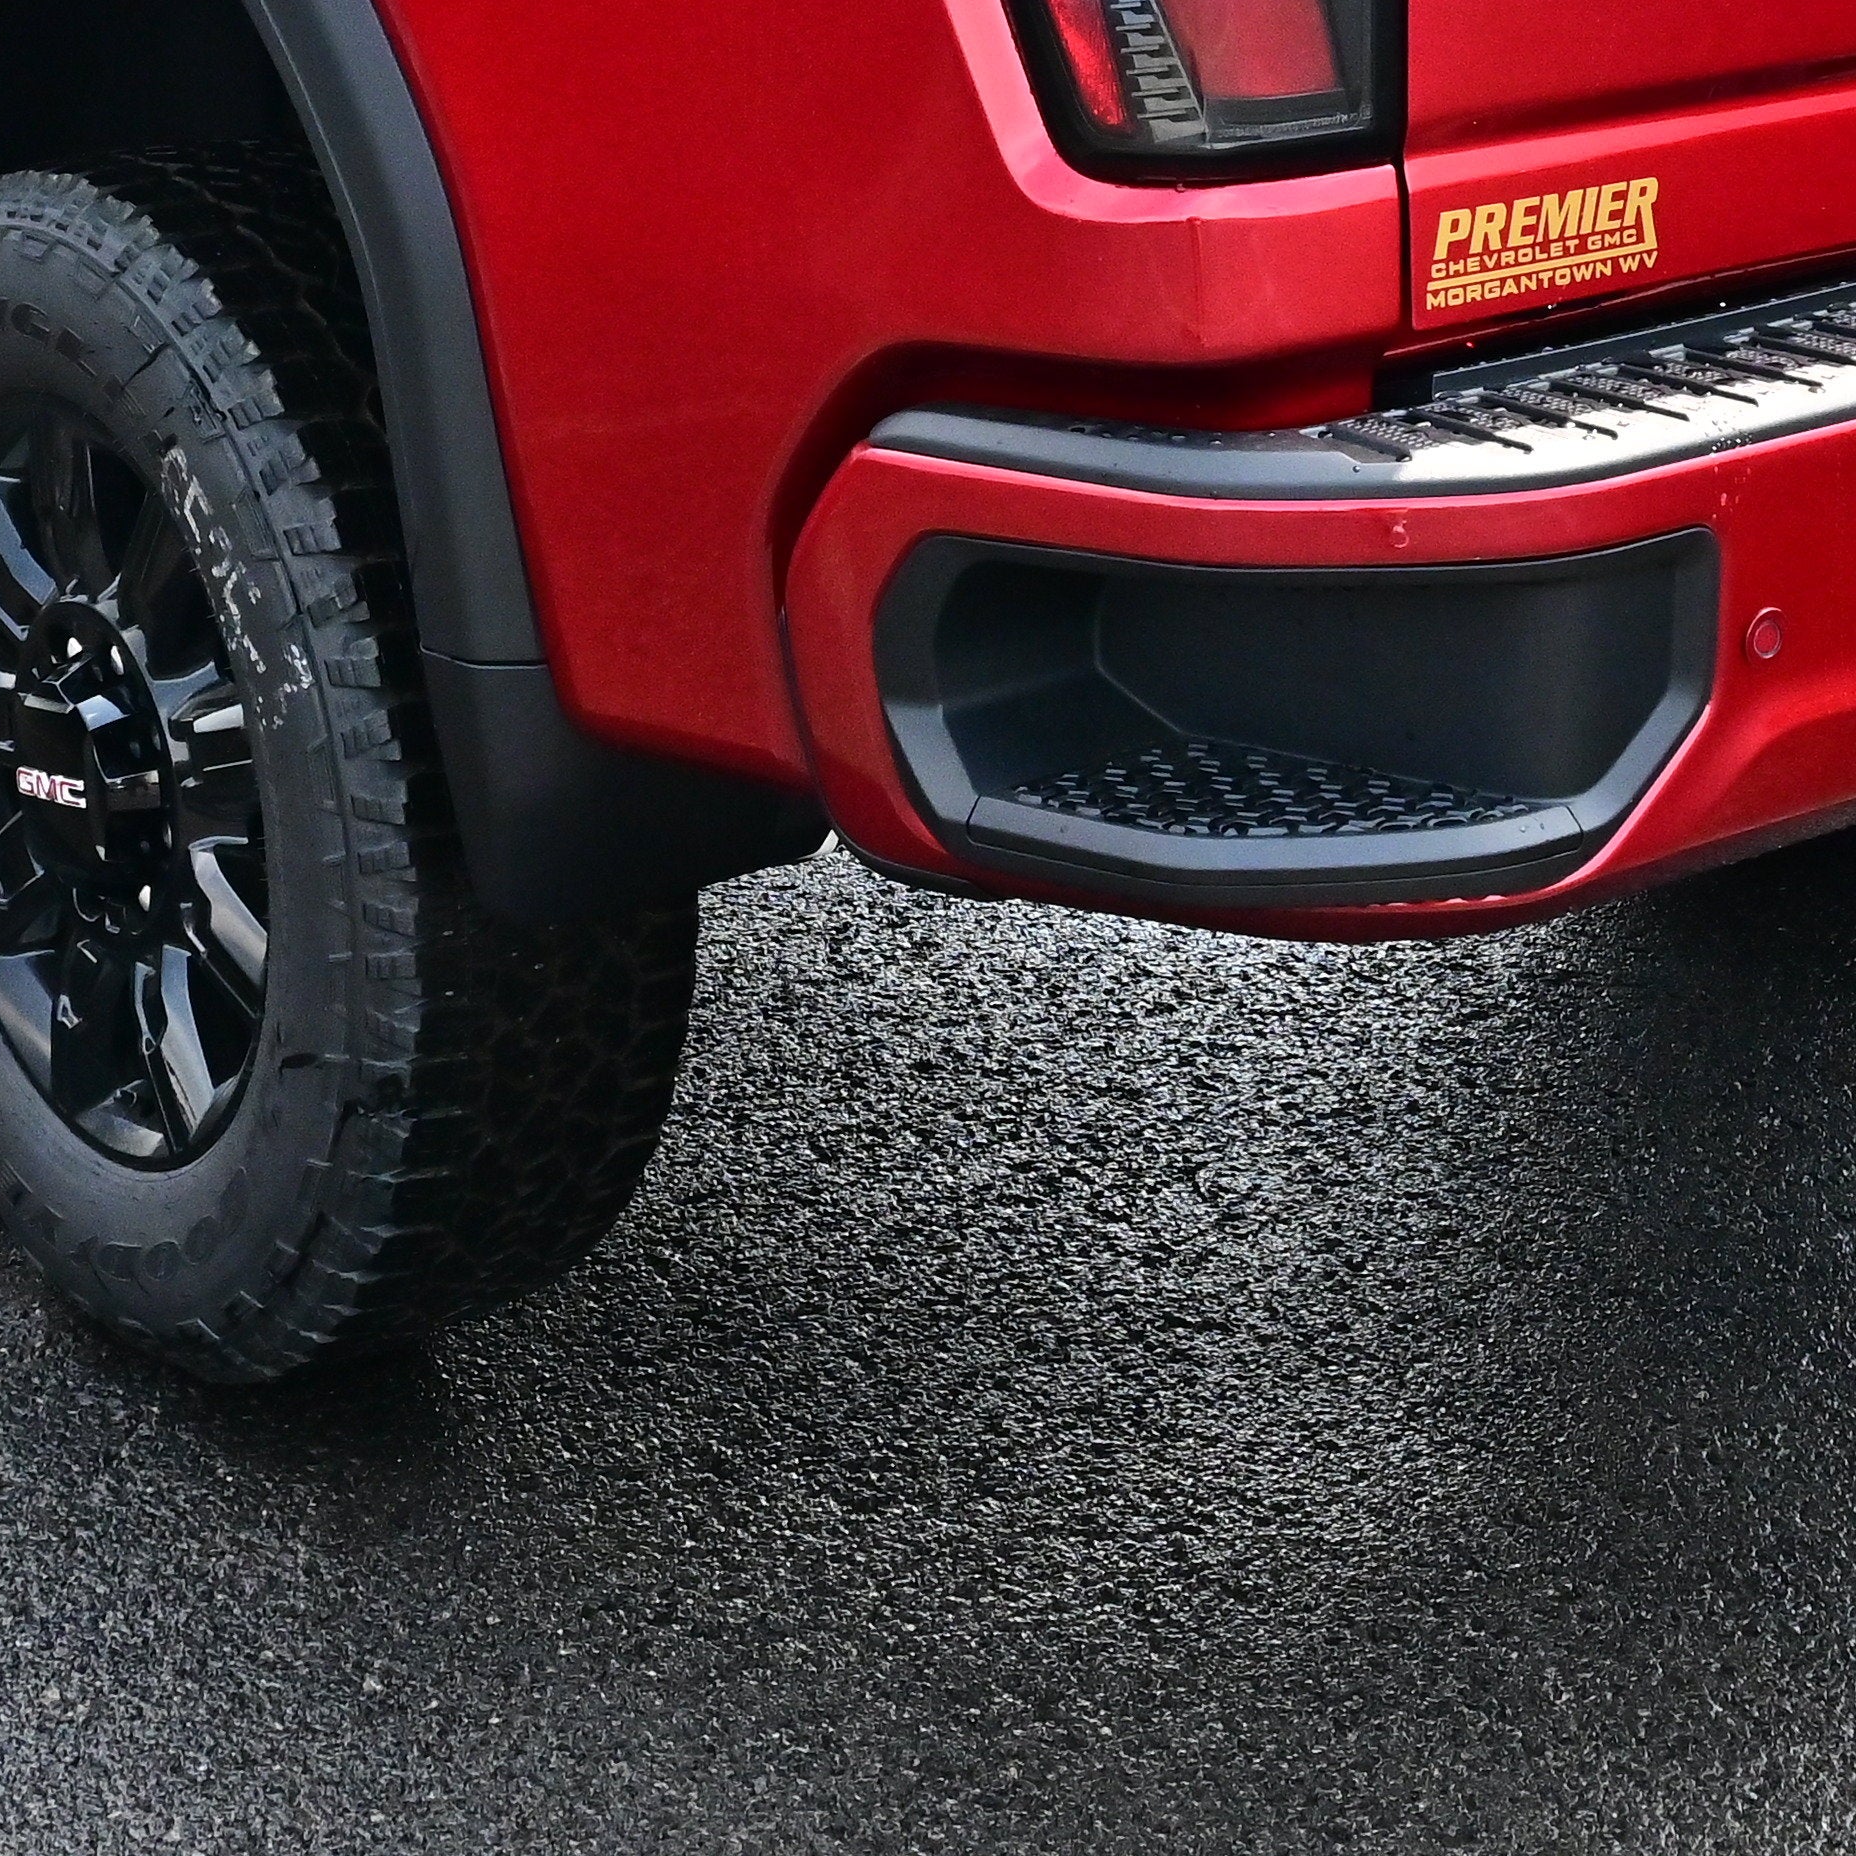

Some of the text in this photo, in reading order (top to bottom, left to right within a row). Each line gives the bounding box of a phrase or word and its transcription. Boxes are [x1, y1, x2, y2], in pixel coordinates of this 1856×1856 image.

[1432, 176, 1659, 262] PREMIER
[1425, 251, 1659, 311] MORGANTOWN WV
[1430, 228, 1638, 279] CHEVROLET GMC
[16, 766, 87, 809] GMC
